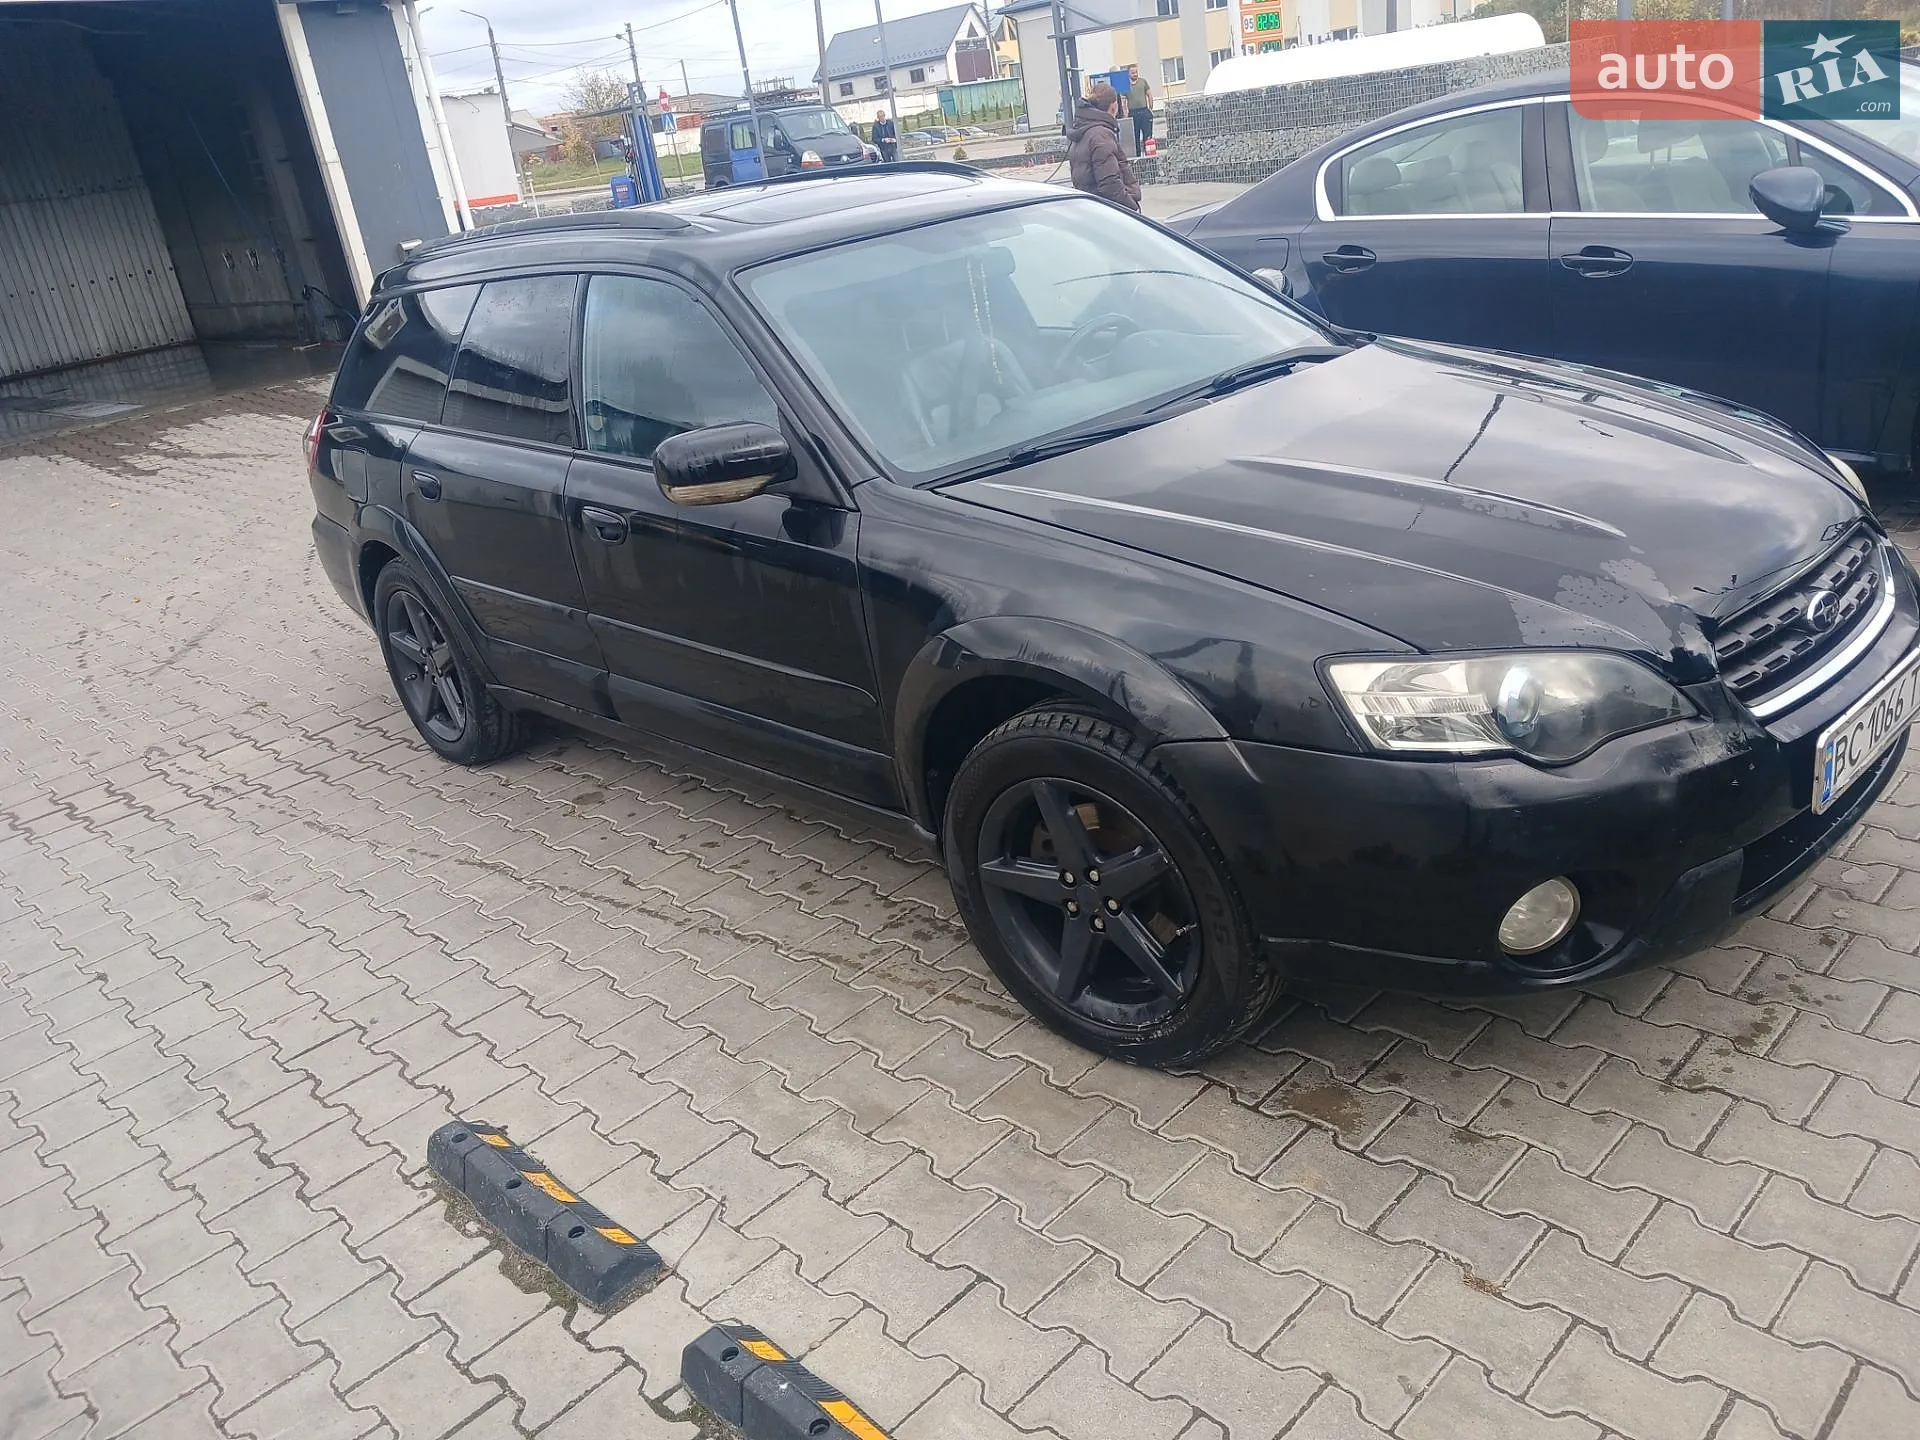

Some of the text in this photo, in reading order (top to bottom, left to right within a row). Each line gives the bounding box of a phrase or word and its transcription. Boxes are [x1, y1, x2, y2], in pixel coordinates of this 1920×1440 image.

[1244, 18, 1254, 30] 95
[1834, 722, 1863, 784] BC
[1867, 679, 1907, 749] 1066
